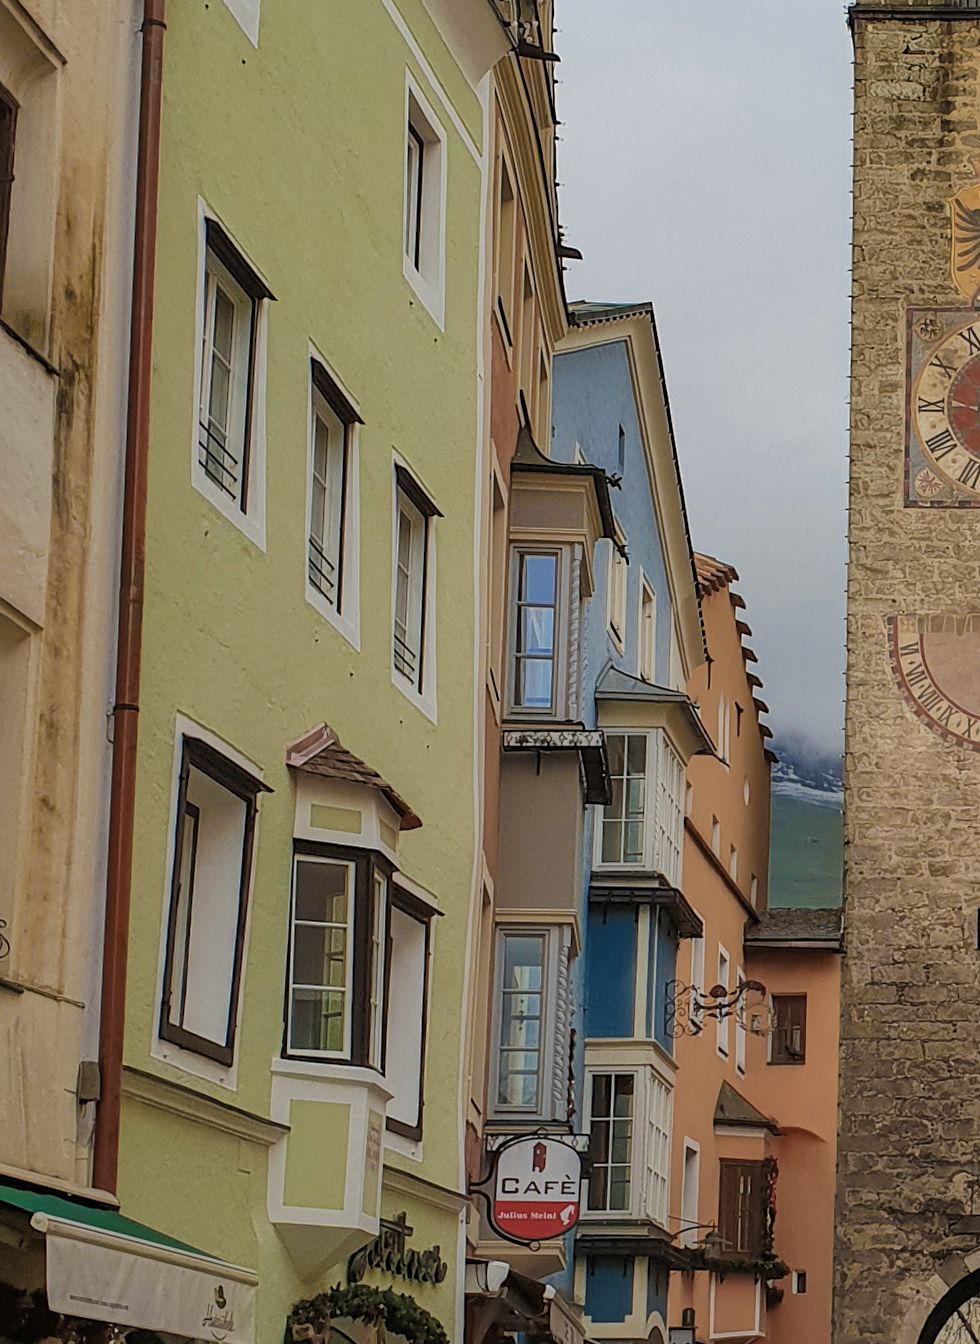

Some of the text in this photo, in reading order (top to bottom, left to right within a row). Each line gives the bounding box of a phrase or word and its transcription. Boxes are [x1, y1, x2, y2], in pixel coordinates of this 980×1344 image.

[929, 355, 958, 379] X
[925, 429, 957, 462] VIII
[900, 642, 919, 657] VI
[905, 662, 928, 687] VII
[917, 683, 945, 712] VIII
[938, 704, 959, 732] IX
[962, 719, 977, 739] X
[501, 1174, 576, 1195] CAFÈ
[498, 1211, 557, 1220] Julius Meinl
